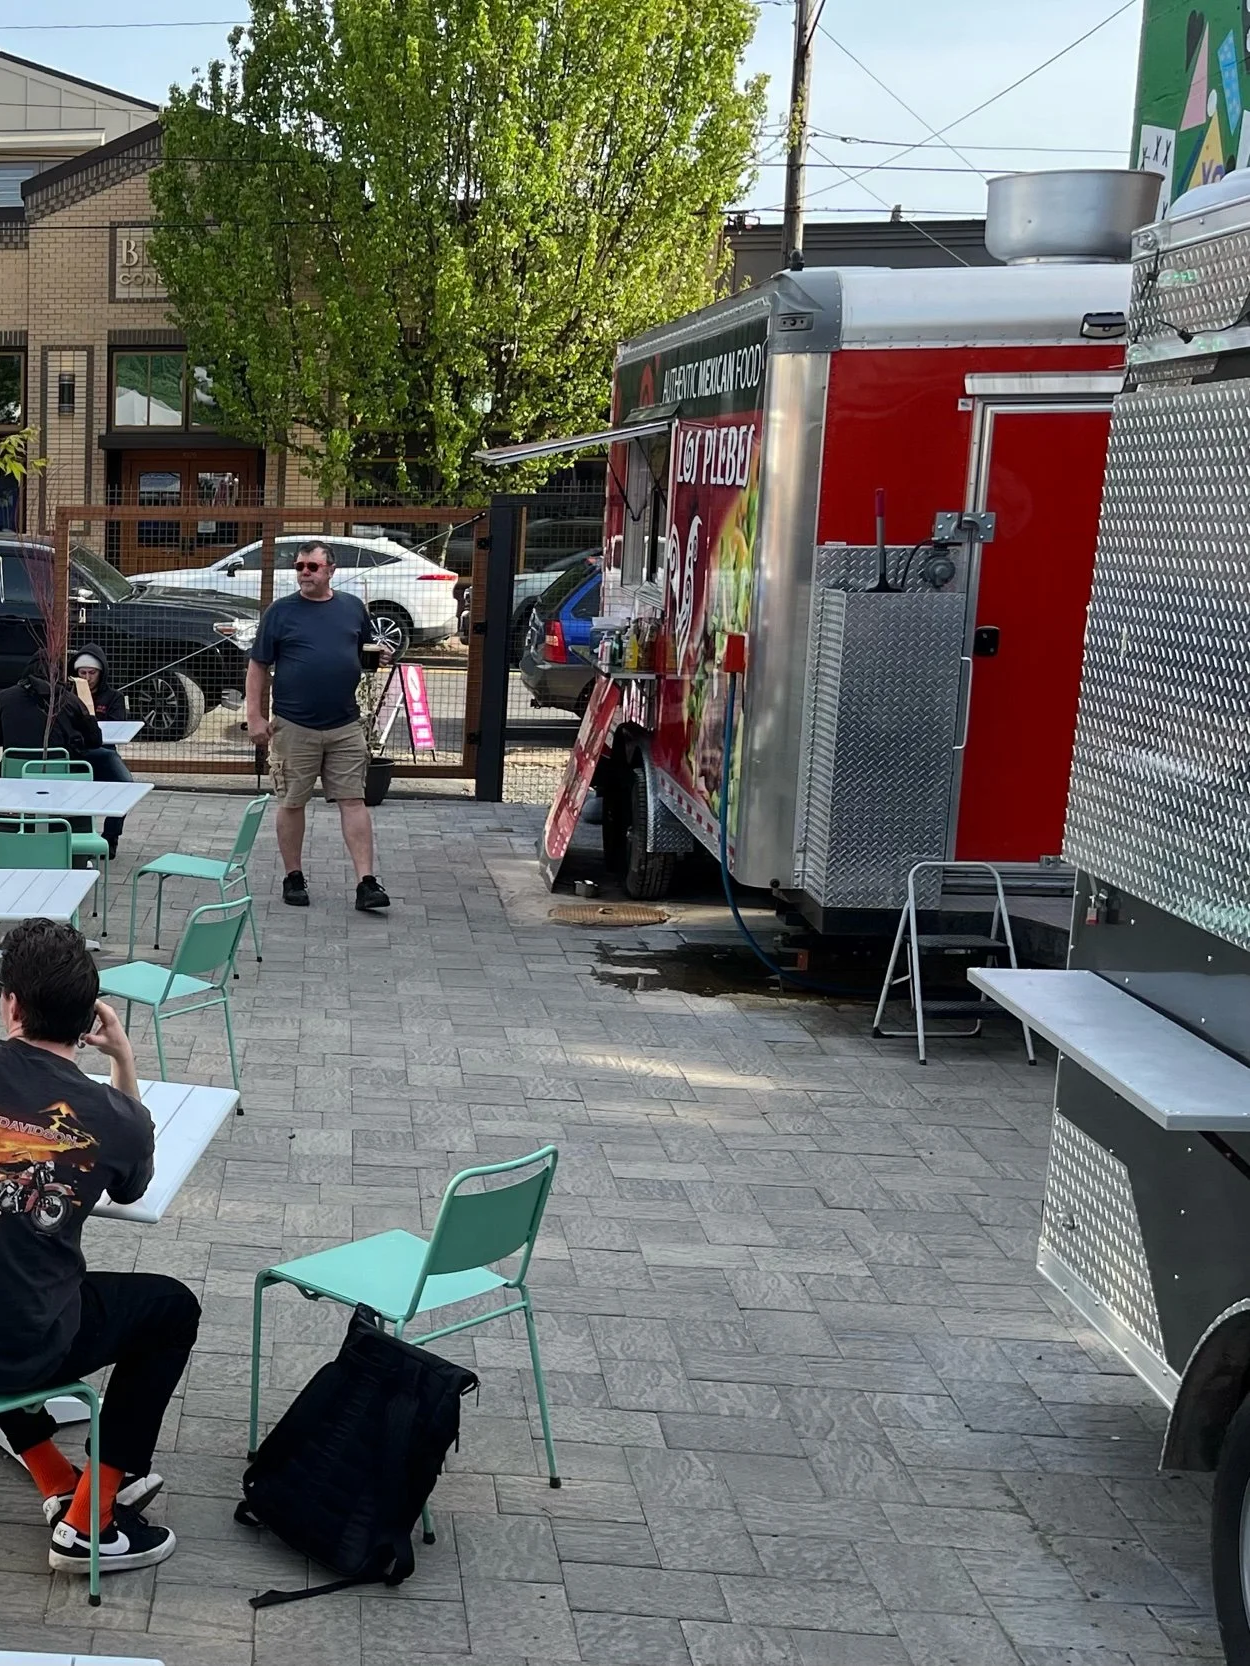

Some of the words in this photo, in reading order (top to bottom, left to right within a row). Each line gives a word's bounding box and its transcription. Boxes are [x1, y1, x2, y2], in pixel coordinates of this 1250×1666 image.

[661, 362, 699, 404] AUTHENTIC
[698, 352, 735, 396] MEXICAN
[734, 343, 762, 391] FOOD
[677, 430, 702, 485] LOS
[702, 423, 756, 488] PLEBES
